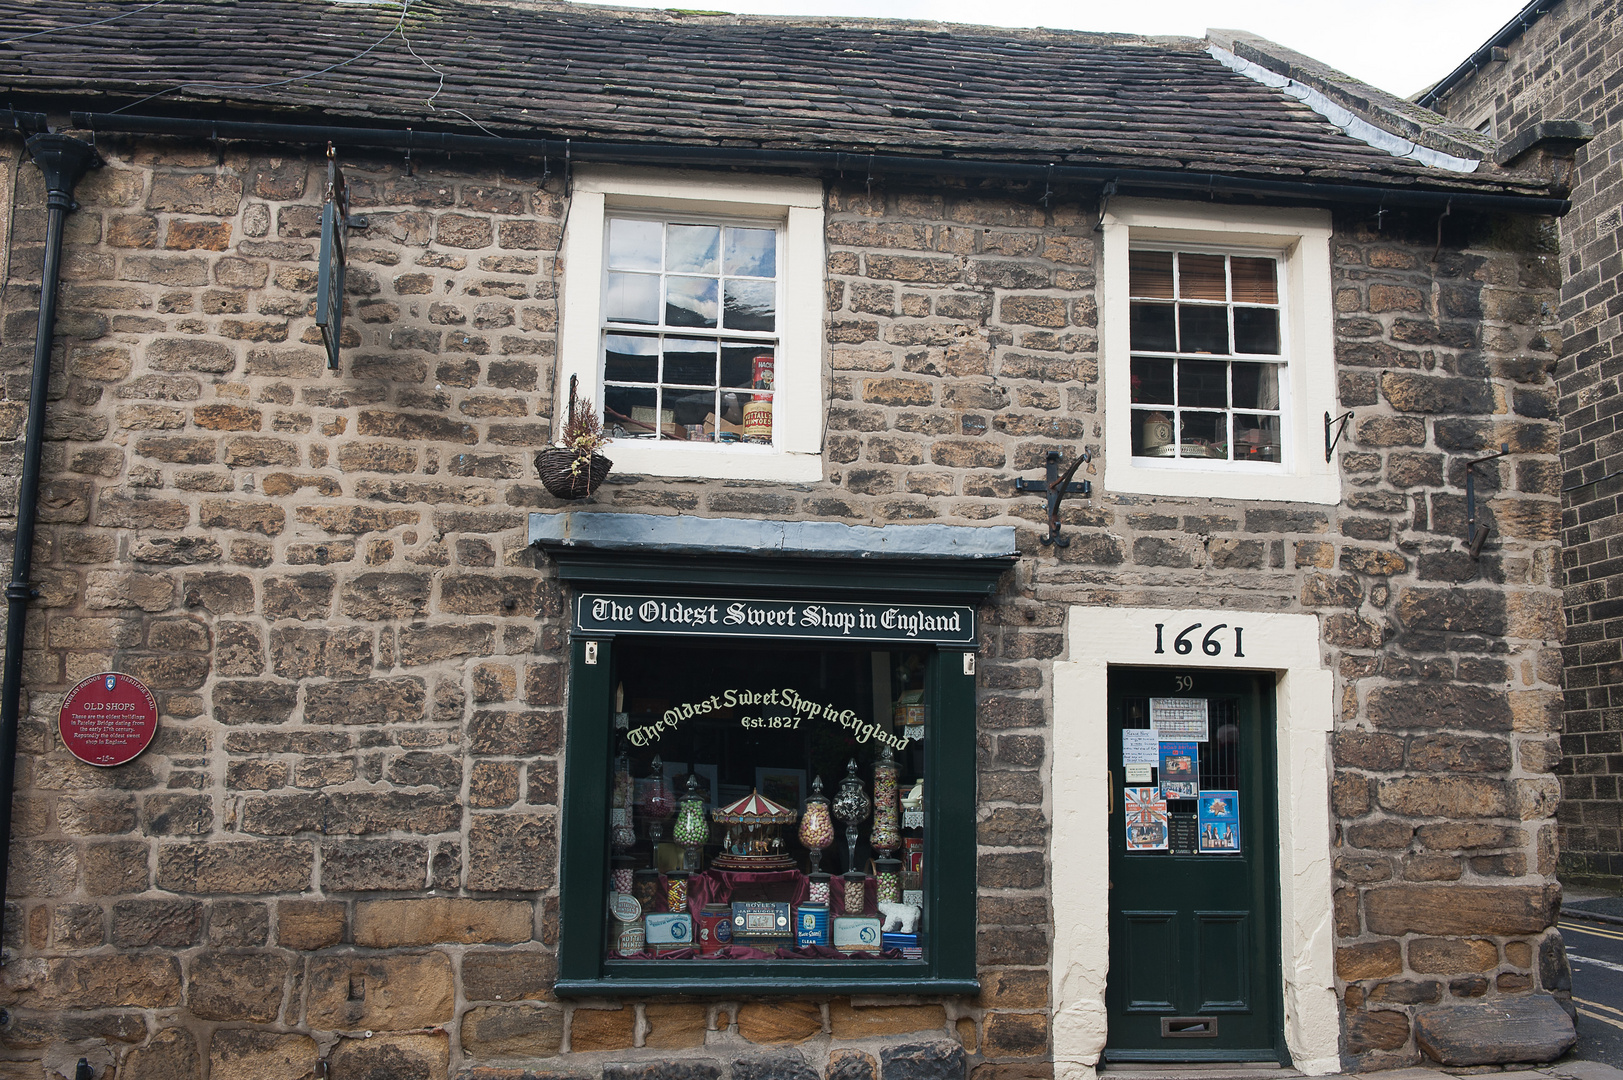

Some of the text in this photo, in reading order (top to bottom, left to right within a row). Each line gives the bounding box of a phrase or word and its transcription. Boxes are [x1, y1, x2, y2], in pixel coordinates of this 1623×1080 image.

[592, 598, 962, 637] The Oldest Sweet Shop in England
[1154, 623, 1245, 658] 1661
[64, 676, 155, 711] PATELEY BRIDGE HERITAGE TRAIL
[1175, 676, 1194, 692] 39
[84, 702, 136, 711] OLD SHOPS
[626, 688, 910, 751] The Oldest Sweet Shop in England
